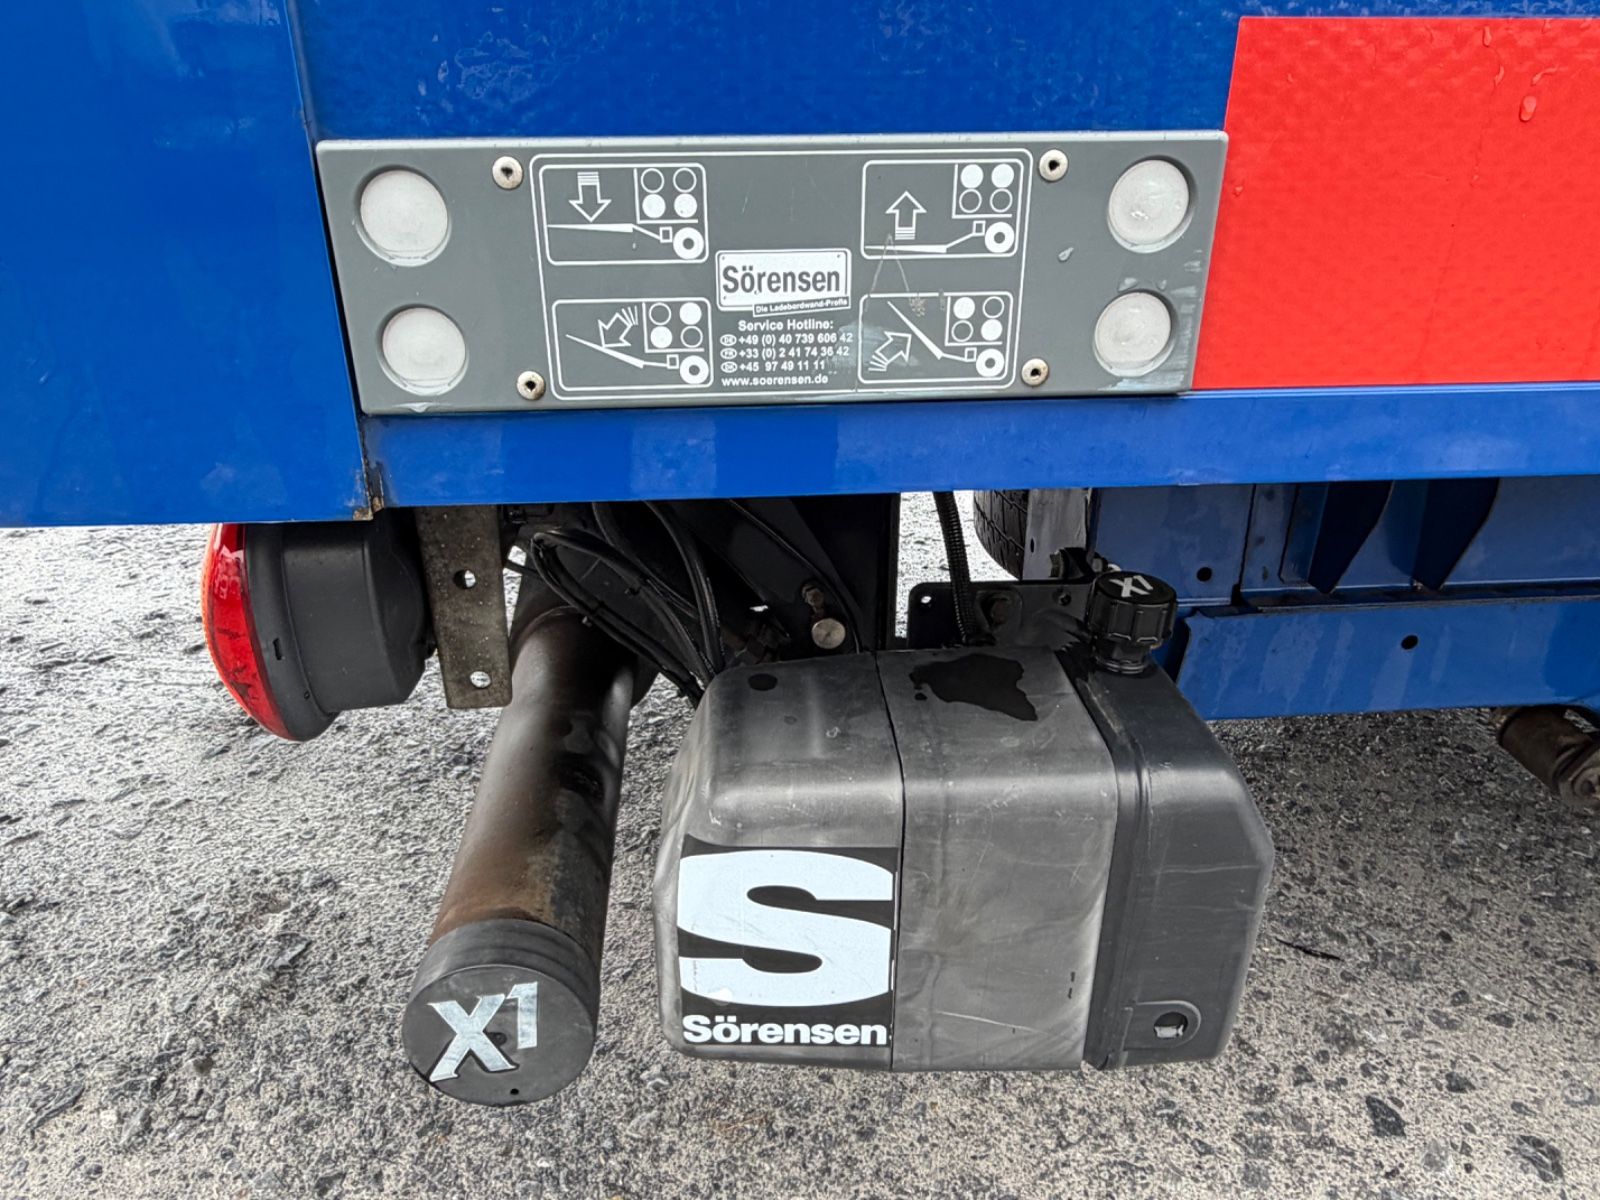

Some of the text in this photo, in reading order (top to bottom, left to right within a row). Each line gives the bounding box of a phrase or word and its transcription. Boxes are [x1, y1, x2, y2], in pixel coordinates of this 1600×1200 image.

[722, 265, 840, 293] Sörensen
[738, 318, 834, 331] Service Hotline:
[739, 335, 758, 345] +49
[762, 334, 776, 346] (0)
[779, 334, 792, 344] 40
[795, 334, 814, 344] 739
[817, 333, 836, 343] 606
[839, 333, 853, 342] 42
[739, 348, 758, 358] +33
[762, 347, 776, 360] (0)
[779, 348, 786, 357] 2
[788, 347, 801, 357] 41
[805, 347, 817, 356] 74
[820, 347, 833, 356] 36
[836, 346, 850, 356] 42
[740, 362, 759, 371] +45
[765, 361, 778, 371] 97
[781, 361, 794, 370] 49
[797, 361, 809, 370] 11
[813, 361, 825, 370] 11
[721, 374, 828, 386] www.soerensen.de
[677, 850, 893, 1006] S
[427, 982, 538, 1082] X1
[682, 1014, 888, 1044] Sörensen
